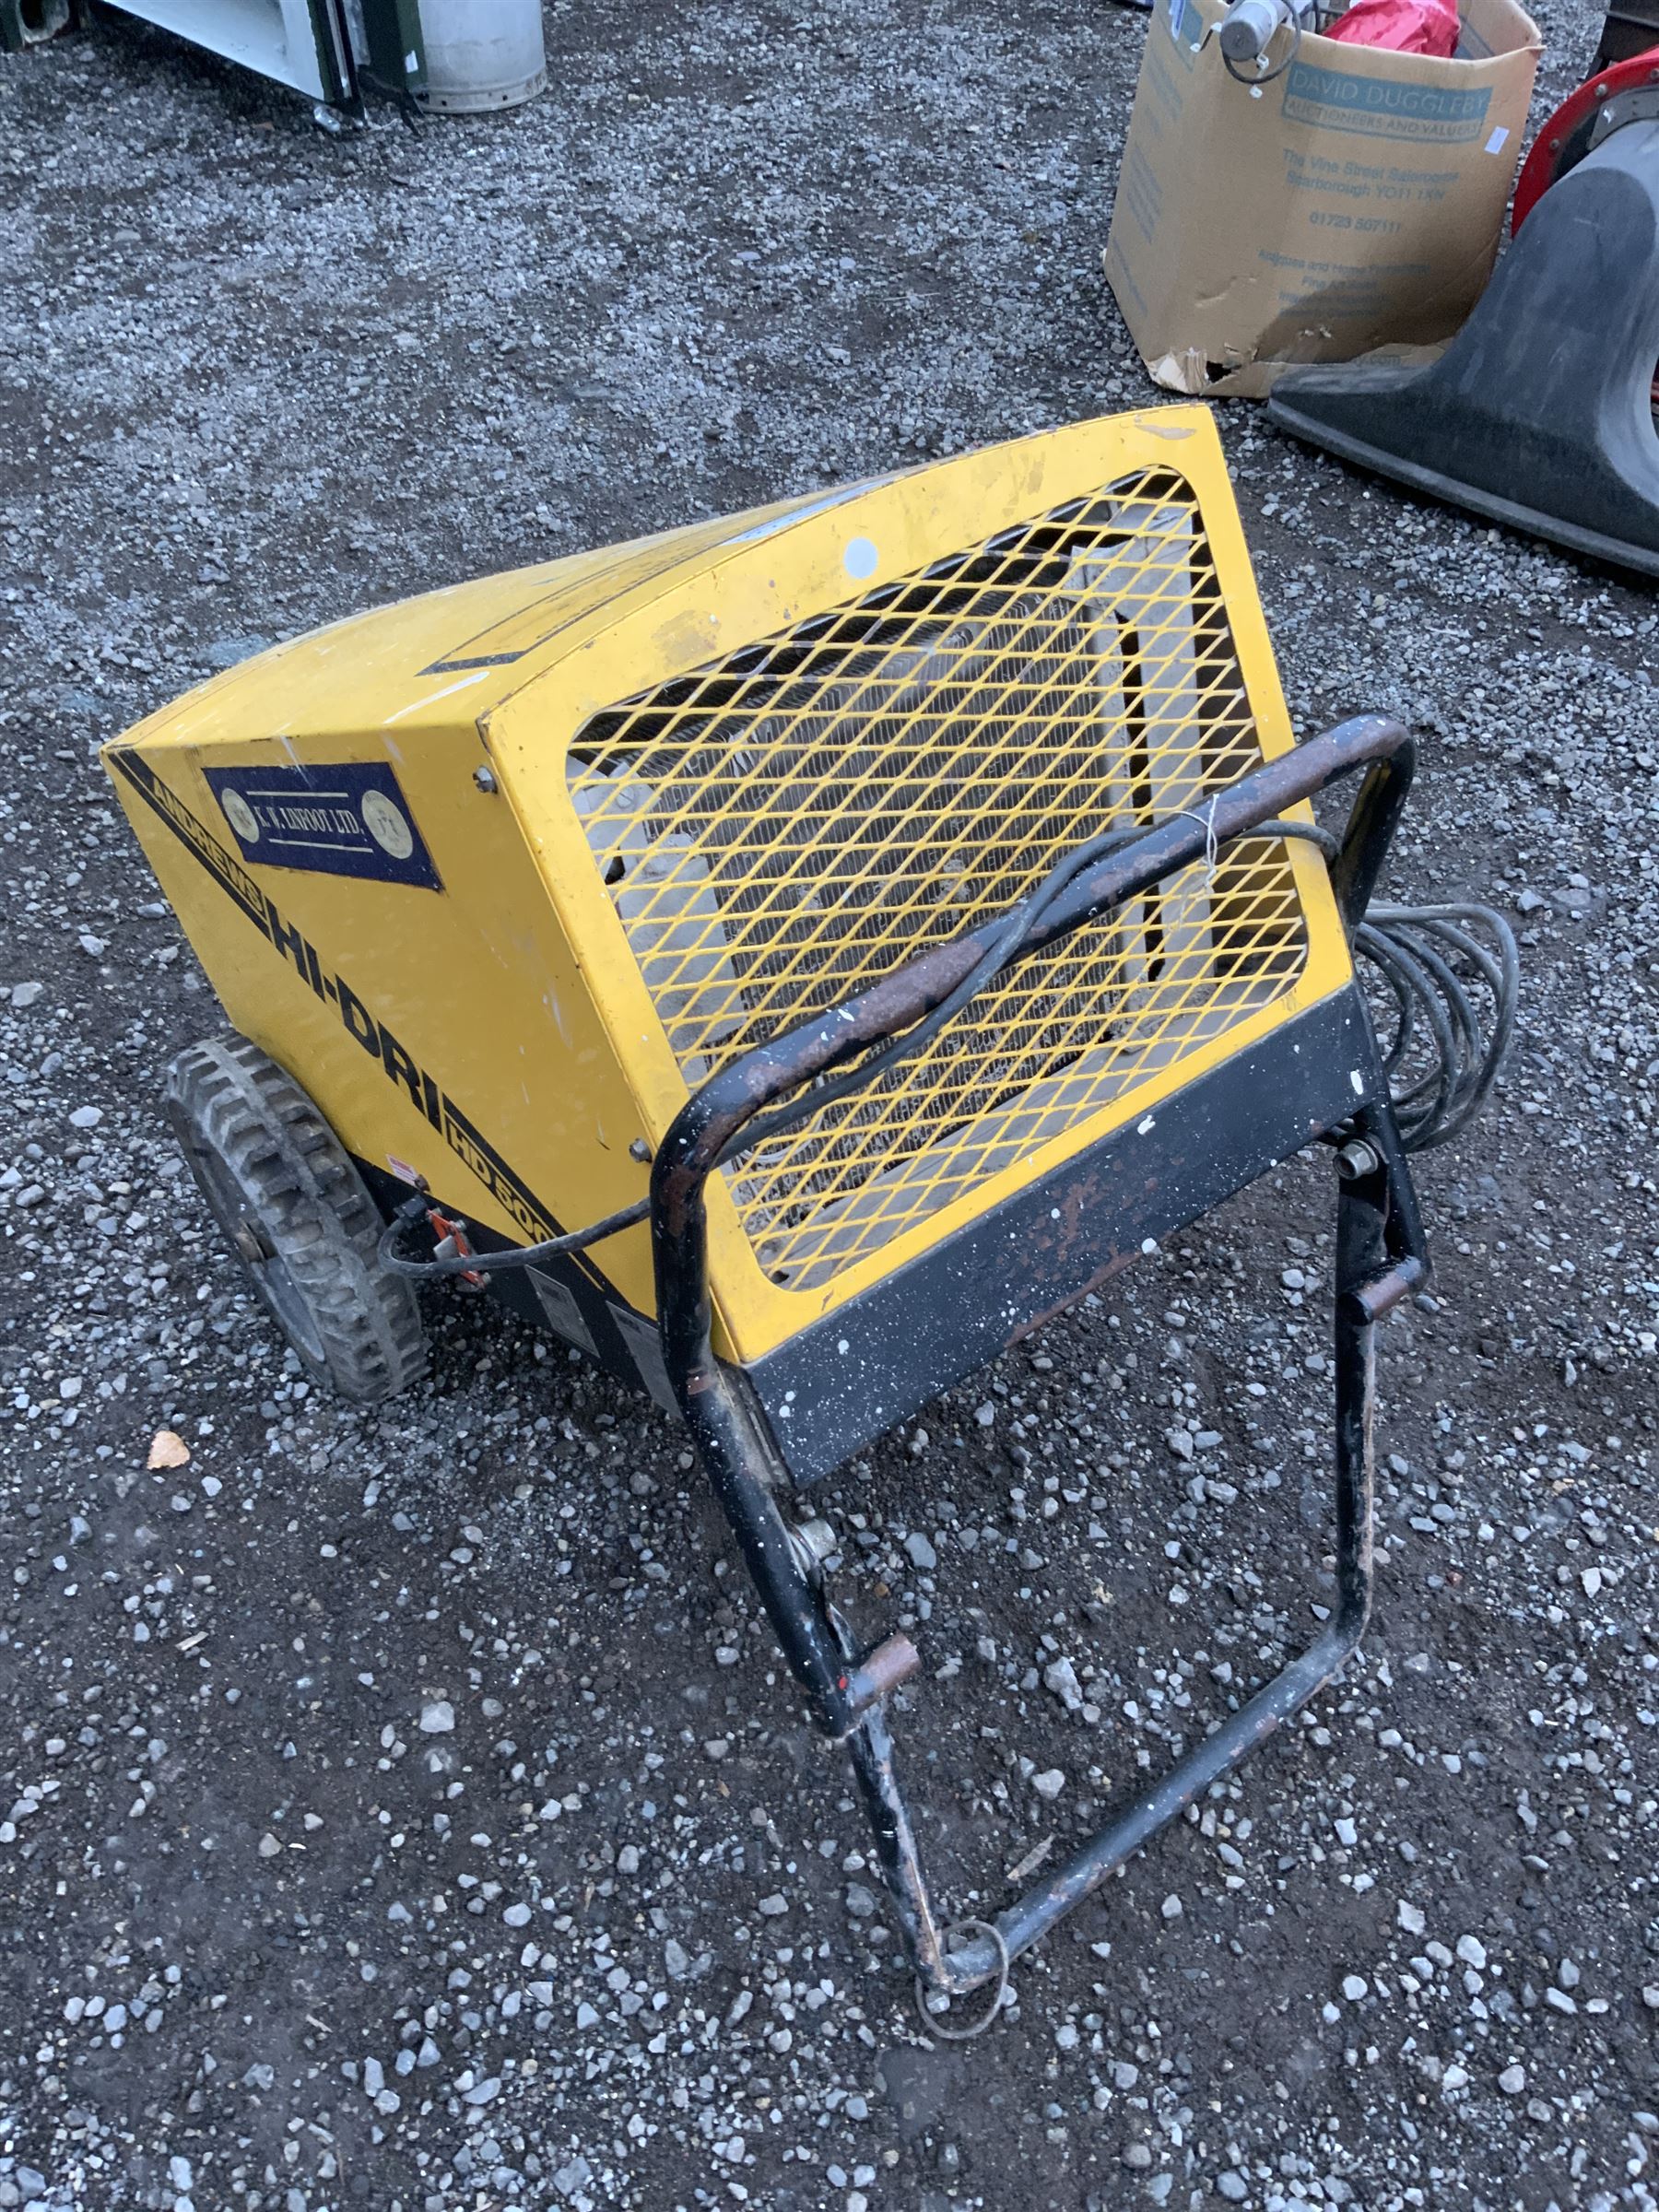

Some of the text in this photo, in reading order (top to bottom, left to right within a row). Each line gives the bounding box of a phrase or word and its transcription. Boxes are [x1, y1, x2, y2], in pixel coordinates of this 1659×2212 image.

[1292, 69, 1358, 100] DAVID
[1386, 119, 1419, 134] AND
[279, 807, 334, 832] LINFOOT
[153, 776, 265, 913] ANDREWS
[265, 894, 443, 1136] HI-DRI
